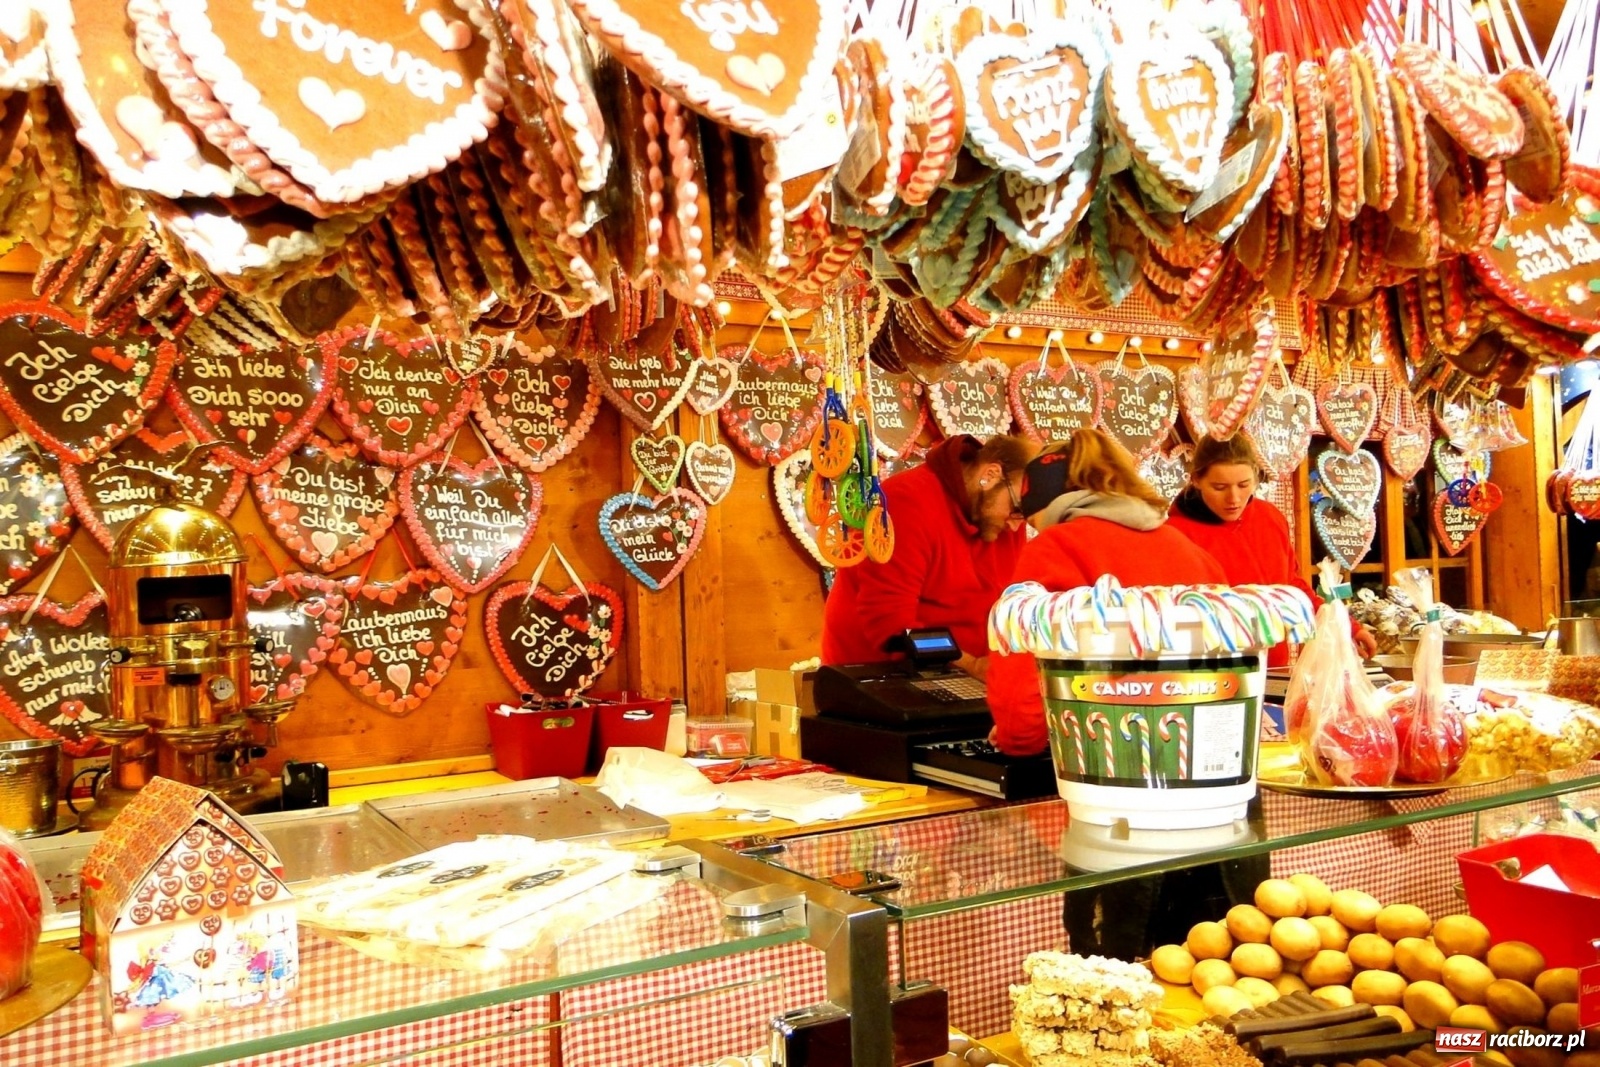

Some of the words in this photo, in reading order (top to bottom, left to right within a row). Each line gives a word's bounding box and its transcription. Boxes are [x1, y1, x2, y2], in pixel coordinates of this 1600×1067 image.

[5, 340, 77, 380] Ich
[192, 357, 232, 378] Ich
[238, 356, 286, 379] liebe
[358, 359, 391, 382] Ich
[395, 366, 443, 384] denke
[514, 369, 551, 395] Ich
[612, 373, 632, 388] nie
[632, 374, 660, 388] mehr
[187, 385, 243, 407] Dich
[364, 383, 395, 397] nur
[406, 385, 433, 400] an
[735, 377, 818, 395] aubermaus
[958, 382, 985, 403] Ich
[1119, 386, 1147, 408] Ich
[62, 376, 126, 422] Dich
[375, 398, 421, 415] Dich
[739, 391, 762, 406] ich
[766, 391, 801, 408] liebe
[227, 405, 271, 428] sehr
[751, 407, 788, 422] Dich
[875, 413, 904, 429] Dich
[1034, 413, 1052, 429] für
[1056, 417, 1082, 429] mich
[513, 418, 560, 436] Dich
[1121, 422, 1153, 437] Dich
[652, 447, 670, 458] bist
[290, 467, 326, 487] Du
[329, 471, 365, 495] bist
[273, 487, 330, 507] meine
[332, 493, 386, 519] große
[433, 485, 467, 505] Weil
[471, 489, 503, 509] Du
[299, 506, 366, 537] Liebe
[425, 505, 492, 526] einfach
[492, 510, 527, 528] alles
[435, 521, 468, 543] für
[472, 525, 511, 544] mich
[622, 532, 656, 547] mein
[454, 540, 494, 557] bist
[632, 547, 676, 563] Glück
[352, 629, 386, 649] ich
[385, 625, 432, 644] liebe
[511, 613, 557, 647] Ich
[3, 638, 49, 676] Auf
[374, 644, 420, 663] Dich
[545, 643, 588, 682] Dich
[18, 653, 96, 693] schweb
[25, 688, 60, 716] nur
[61, 675, 96, 697] mit
[1092, 681, 1154, 697] CANDY
